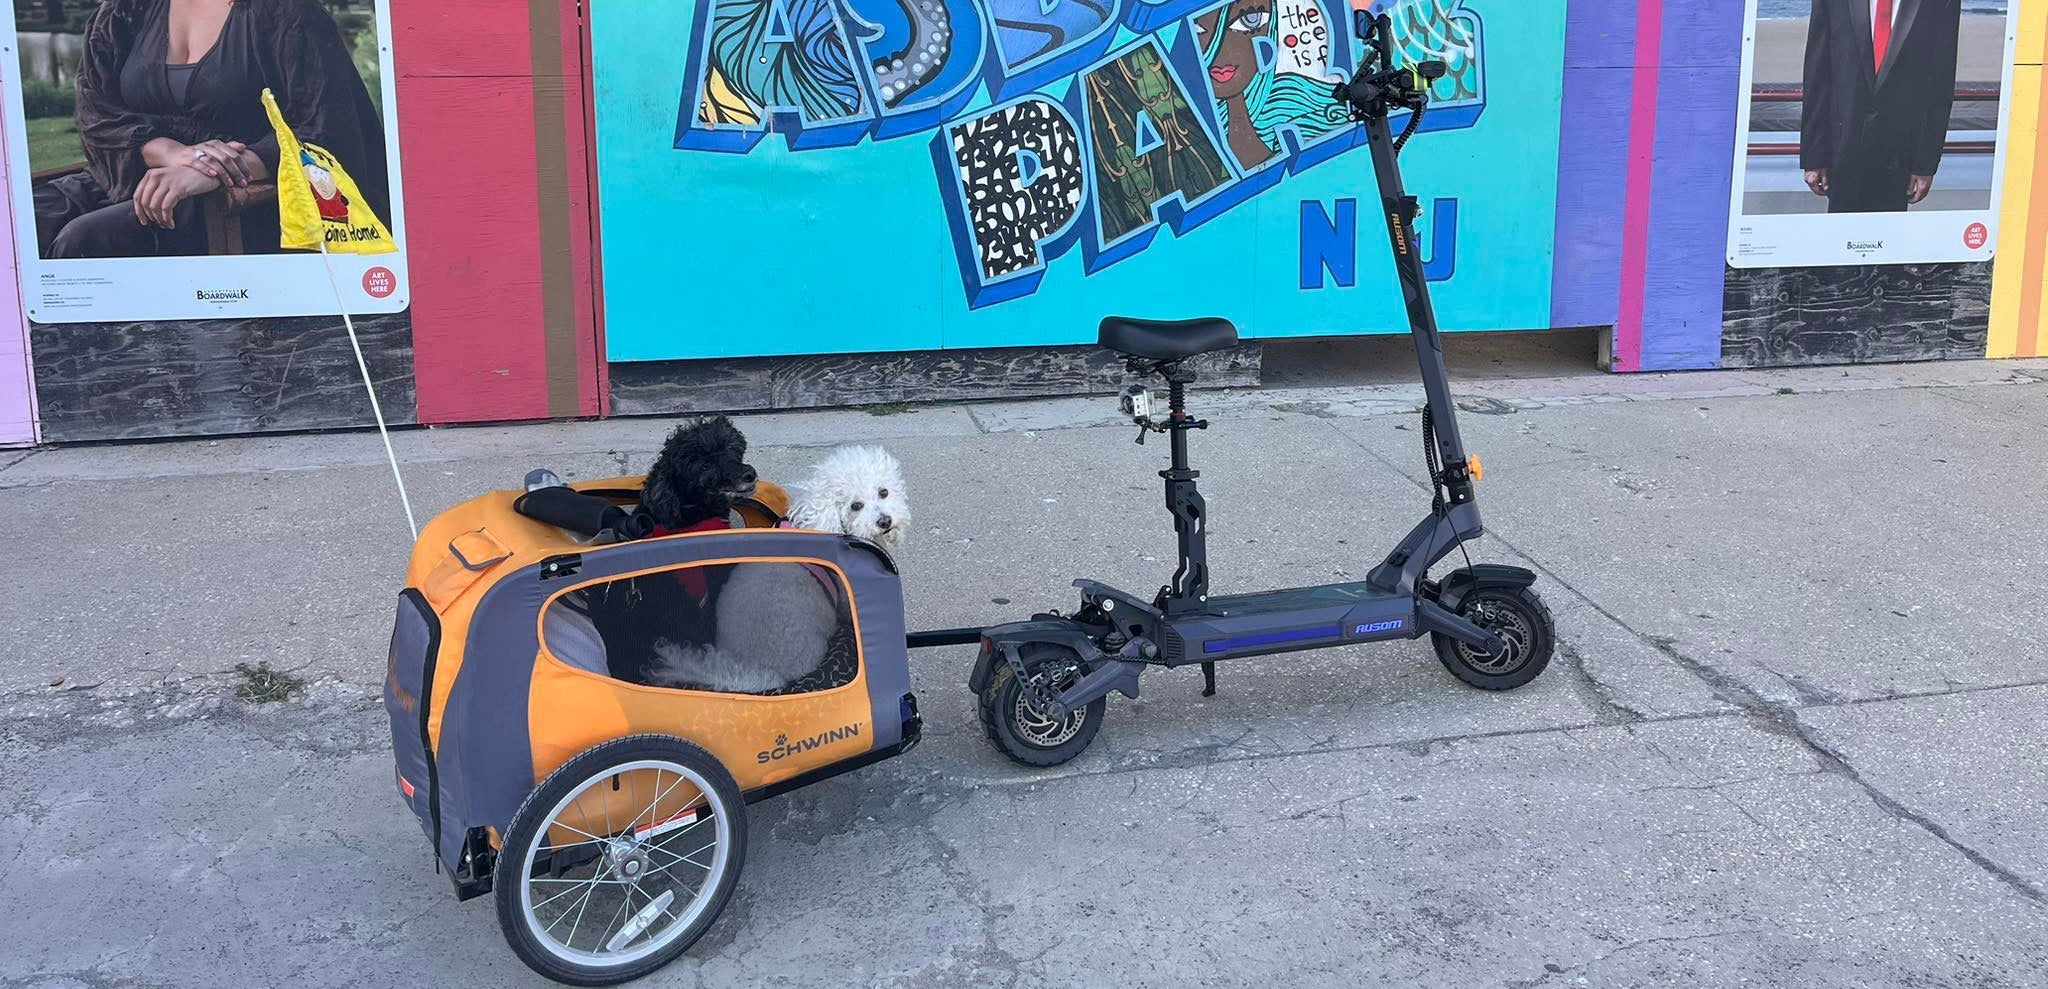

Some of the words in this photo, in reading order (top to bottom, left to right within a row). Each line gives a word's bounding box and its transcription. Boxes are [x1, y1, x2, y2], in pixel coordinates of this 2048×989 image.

[1281, 5, 1319, 29] the
[1292, 50, 1311, 68] is
[322, 224, 348, 242] oing
[1391, 213, 1407, 255] AUSOM
[1300, 198, 1357, 289] N
[369, 278, 389, 286] LIVES
[372, 271, 385, 279] ART
[197, 289, 248, 300] BOARDWALK
[370, 285, 388, 293] HERE
[1355, 620, 1402, 633] AUSOM
[757, 723, 860, 764] SCHWINN
